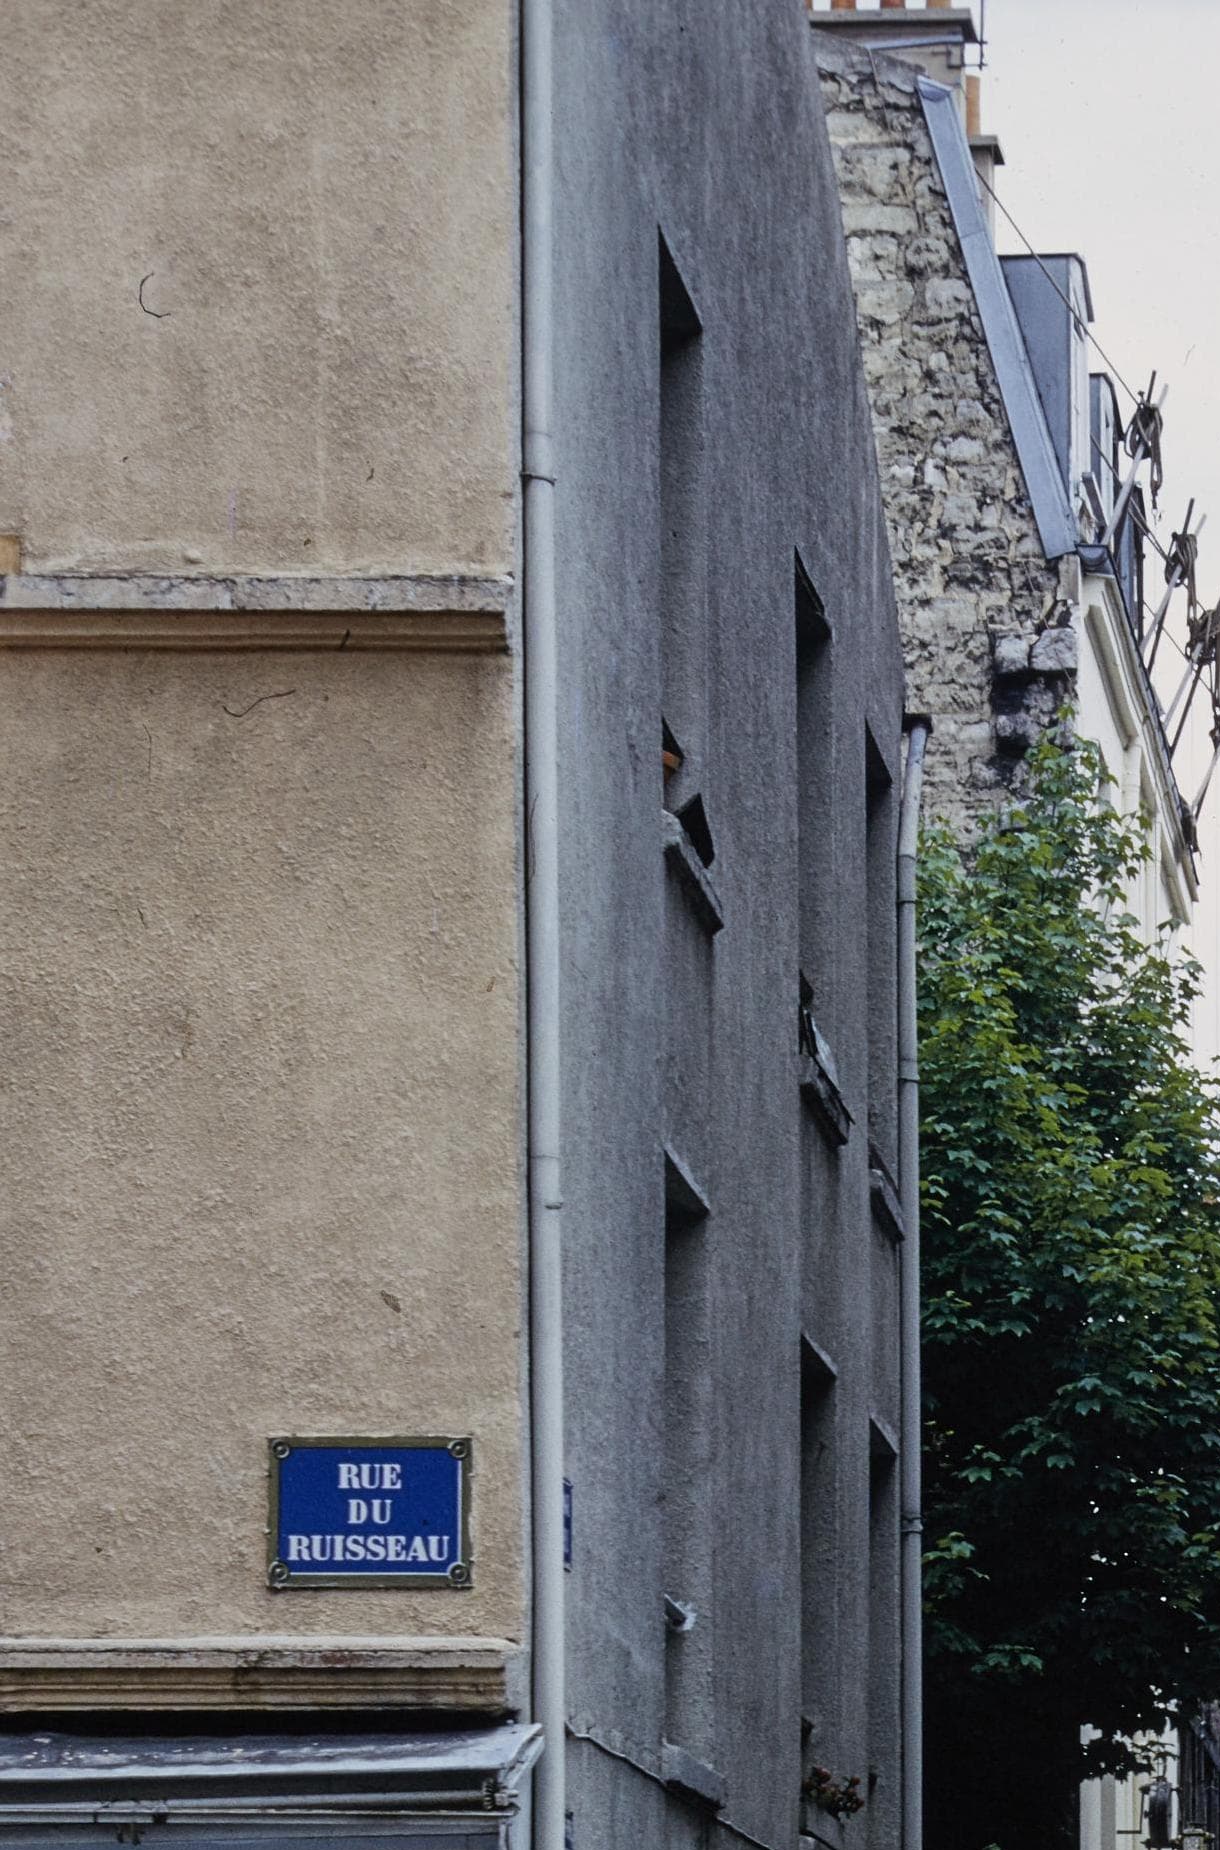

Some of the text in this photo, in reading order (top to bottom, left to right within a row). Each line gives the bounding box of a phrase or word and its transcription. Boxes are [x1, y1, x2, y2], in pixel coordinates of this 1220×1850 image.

[338, 1463, 402, 1490] RUE
[347, 1499, 392, 1524] DU
[287, 1534, 450, 1562] RUISSEAU
